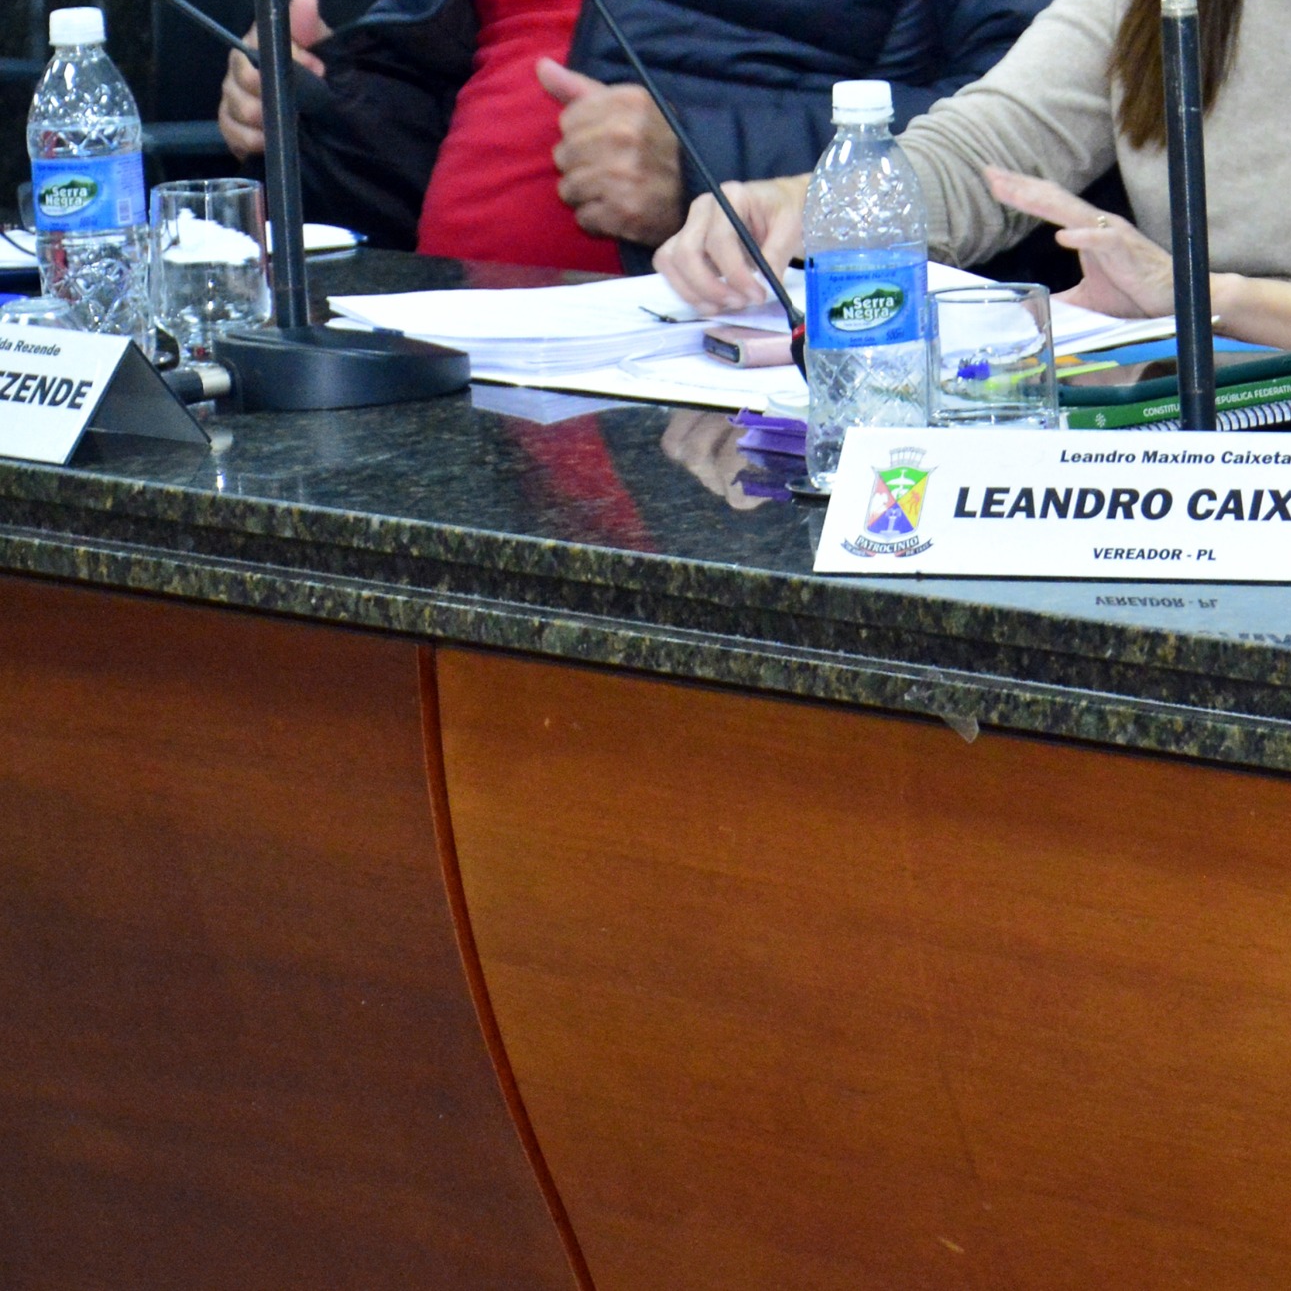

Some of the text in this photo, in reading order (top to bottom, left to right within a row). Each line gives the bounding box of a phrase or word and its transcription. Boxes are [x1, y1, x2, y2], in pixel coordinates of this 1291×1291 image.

[52, 185, 88, 197] Serra
[45, 194, 83, 207] Negra
[853, 296, 894, 310] Serra
[842, 307, 889, 322] Negra
[13, 340, 61, 356] Rezende
[0, 370, 93, 410] ZENDE
[1143, 403, 1181, 417] CONSTITU
[1060, 449, 1291, 465] Leandro Maximo Caixeta
[953, 486, 1173, 520] LEANDRO
[1093, 547, 1182, 560] VEREADOR
[1196, 548, 1216, 561] PL
